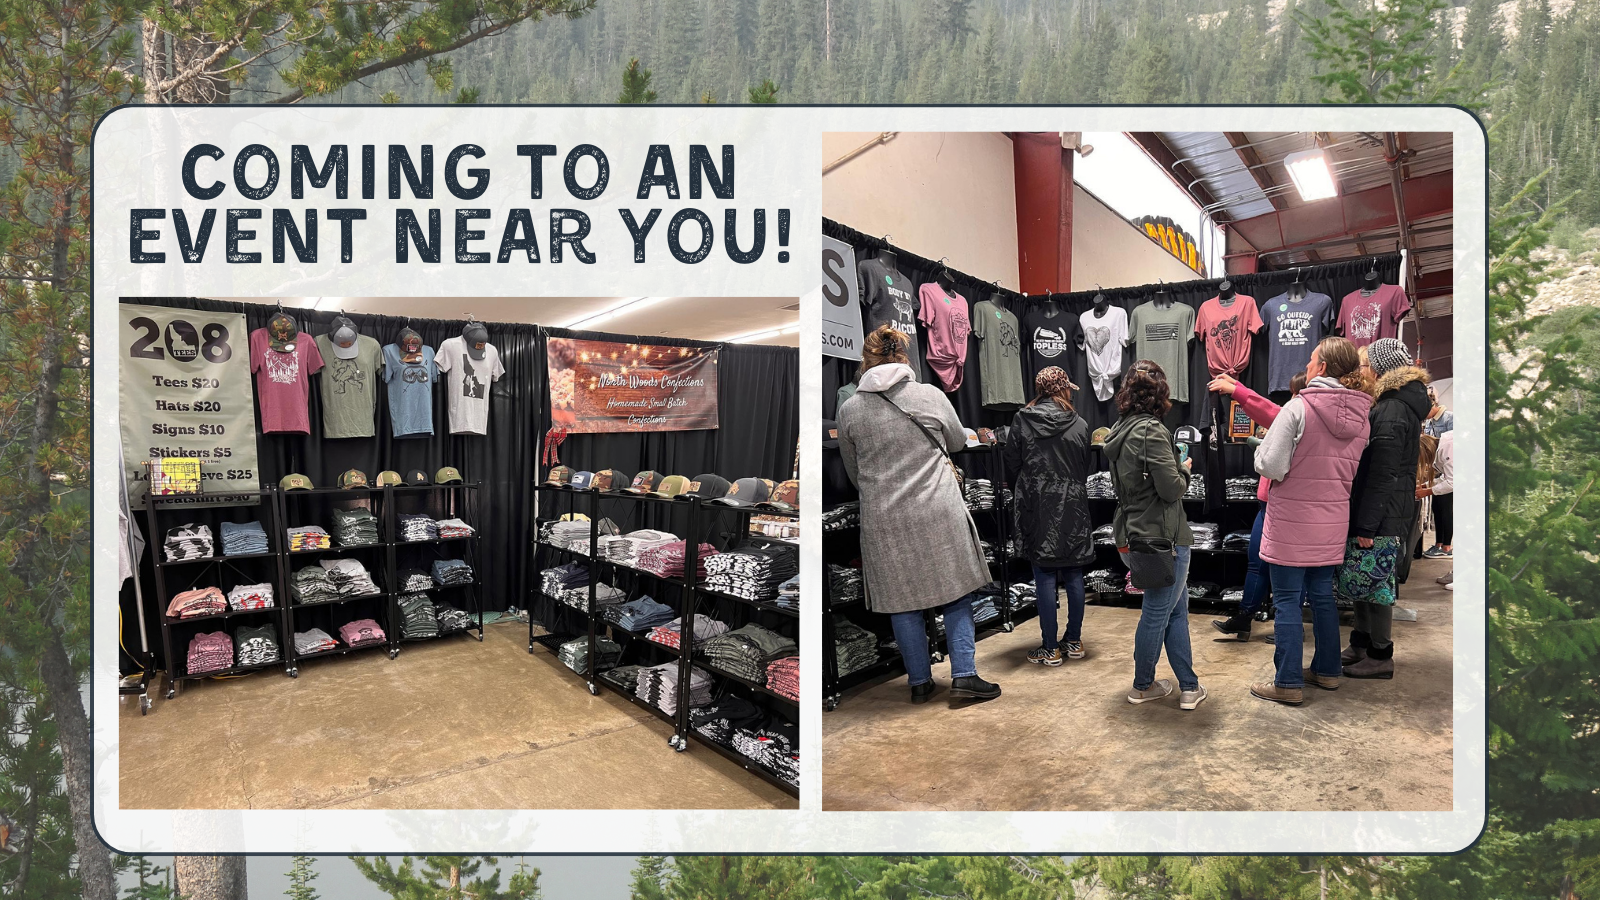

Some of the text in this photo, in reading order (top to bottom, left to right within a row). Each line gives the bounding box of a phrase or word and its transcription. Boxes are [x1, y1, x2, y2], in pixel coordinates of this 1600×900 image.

[1276, 311, 1314, 322] GO OUTSIDE
[128, 316, 232, 363] 208
[1033, 342, 1068, 351] TOPLESS
[152, 375, 220, 389] Tees $20
[598, 374, 704, 392] North Woods Confections
[155, 400, 222, 413] Hats $20
[606, 397, 648, 410] Homemade
[667, 398, 688, 410] Batch
[627, 414, 667, 428] Confections
[152, 423, 225, 437] Signs $10
[149, 447, 232, 458] Stickers $5
[226, 469, 253, 480] $25
